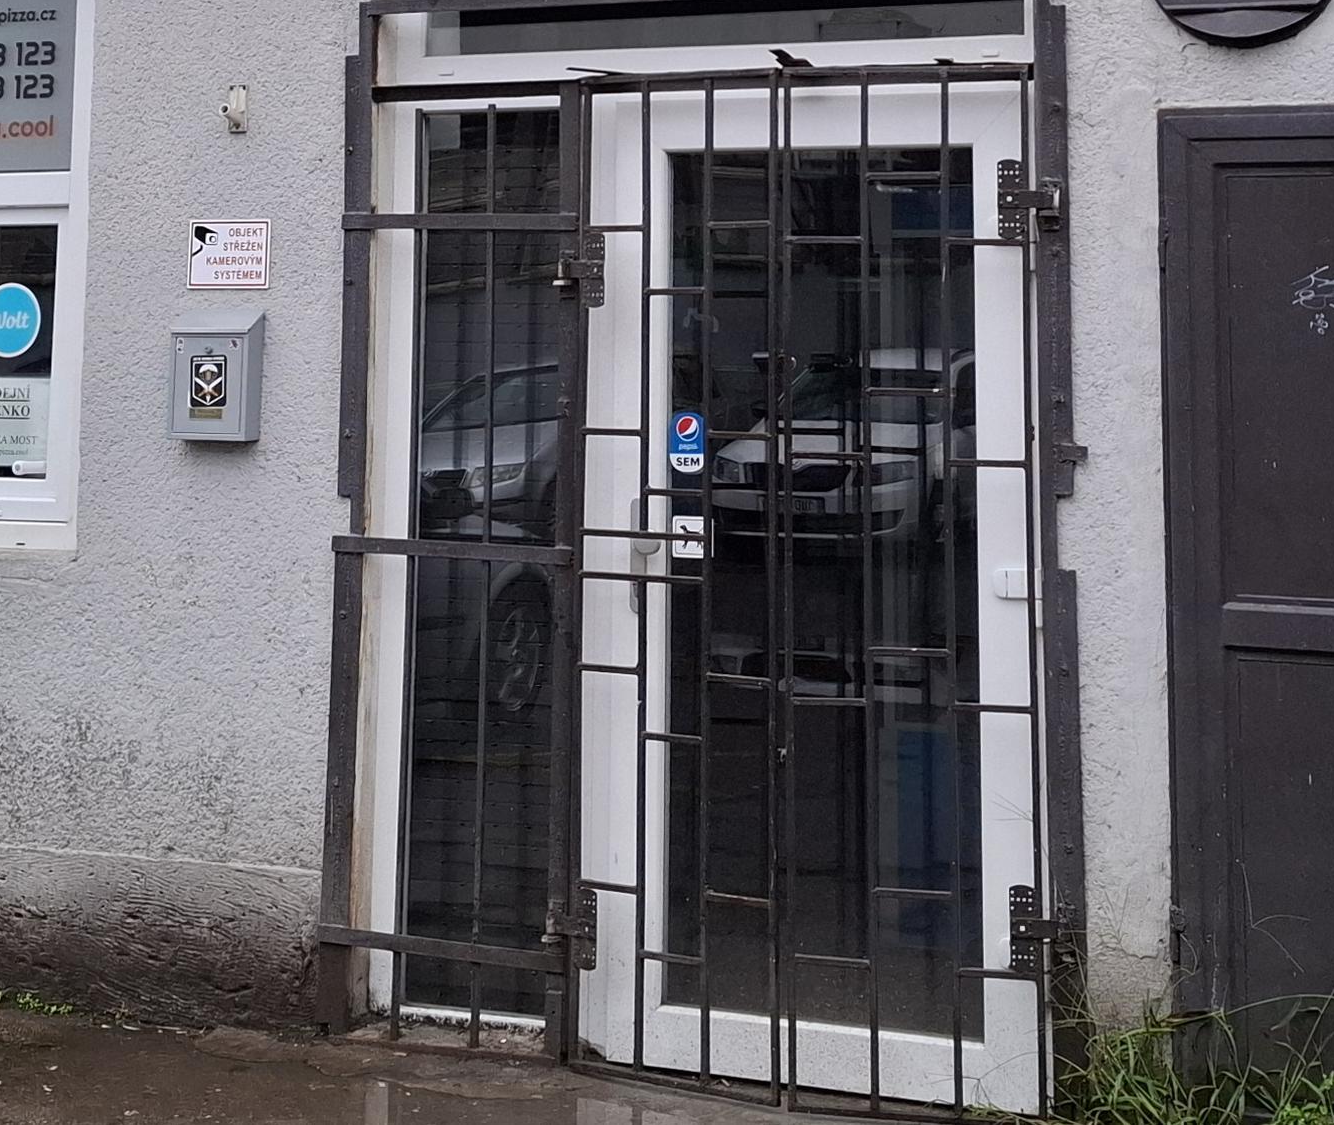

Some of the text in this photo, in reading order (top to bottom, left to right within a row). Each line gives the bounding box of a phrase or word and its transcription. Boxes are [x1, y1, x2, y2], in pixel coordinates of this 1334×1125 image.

[16, 41, 56, 67] 123
[15, 74, 55, 100] 123
[228, 227, 264, 237] OBJEKT
[223, 240, 263, 251] STŘEŽEN
[206, 254, 263, 265] KAMEROVÝM
[10, 435, 38, 445] MOST
[676, 457, 700, 467] SEM
